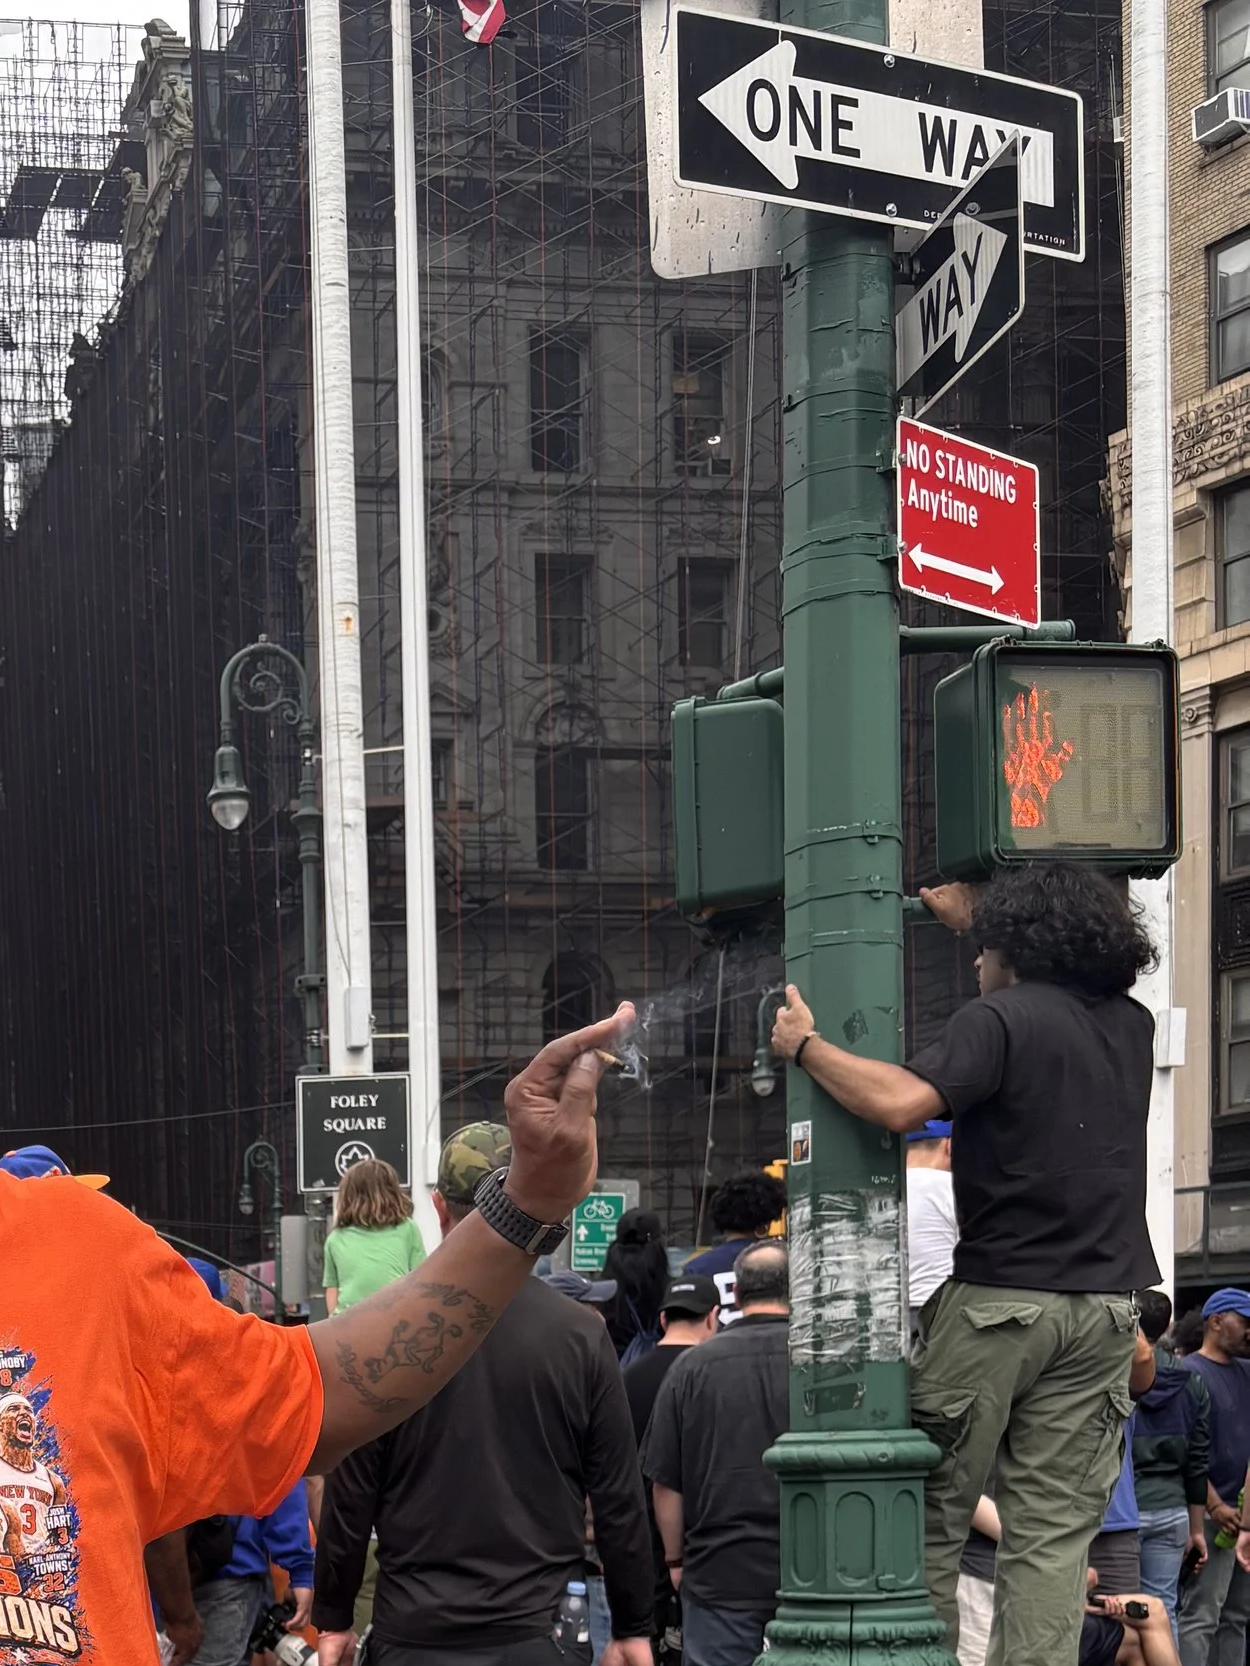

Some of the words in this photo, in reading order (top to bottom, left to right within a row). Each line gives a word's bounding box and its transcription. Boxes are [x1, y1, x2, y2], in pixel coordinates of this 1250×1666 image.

[745, 77, 861, 160] ONE
[919, 231, 984, 356] WAY
[906, 438, 930, 474] NO
[935, 449, 1017, 504] STANDING
[907, 478, 979, 528] Anytime
[330, 1093, 380, 1109] FOLEY
[323, 1116, 387, 1132] SQUARE
[0, 1369, 12, 1387] 8
[20, 1503, 37, 1535] 3
[46, 1514, 71, 1530] HART
[57, 1527, 69, 1545] 3
[34, 1560, 68, 1576] TOWNS
[43, 1572, 65, 1592] 32
